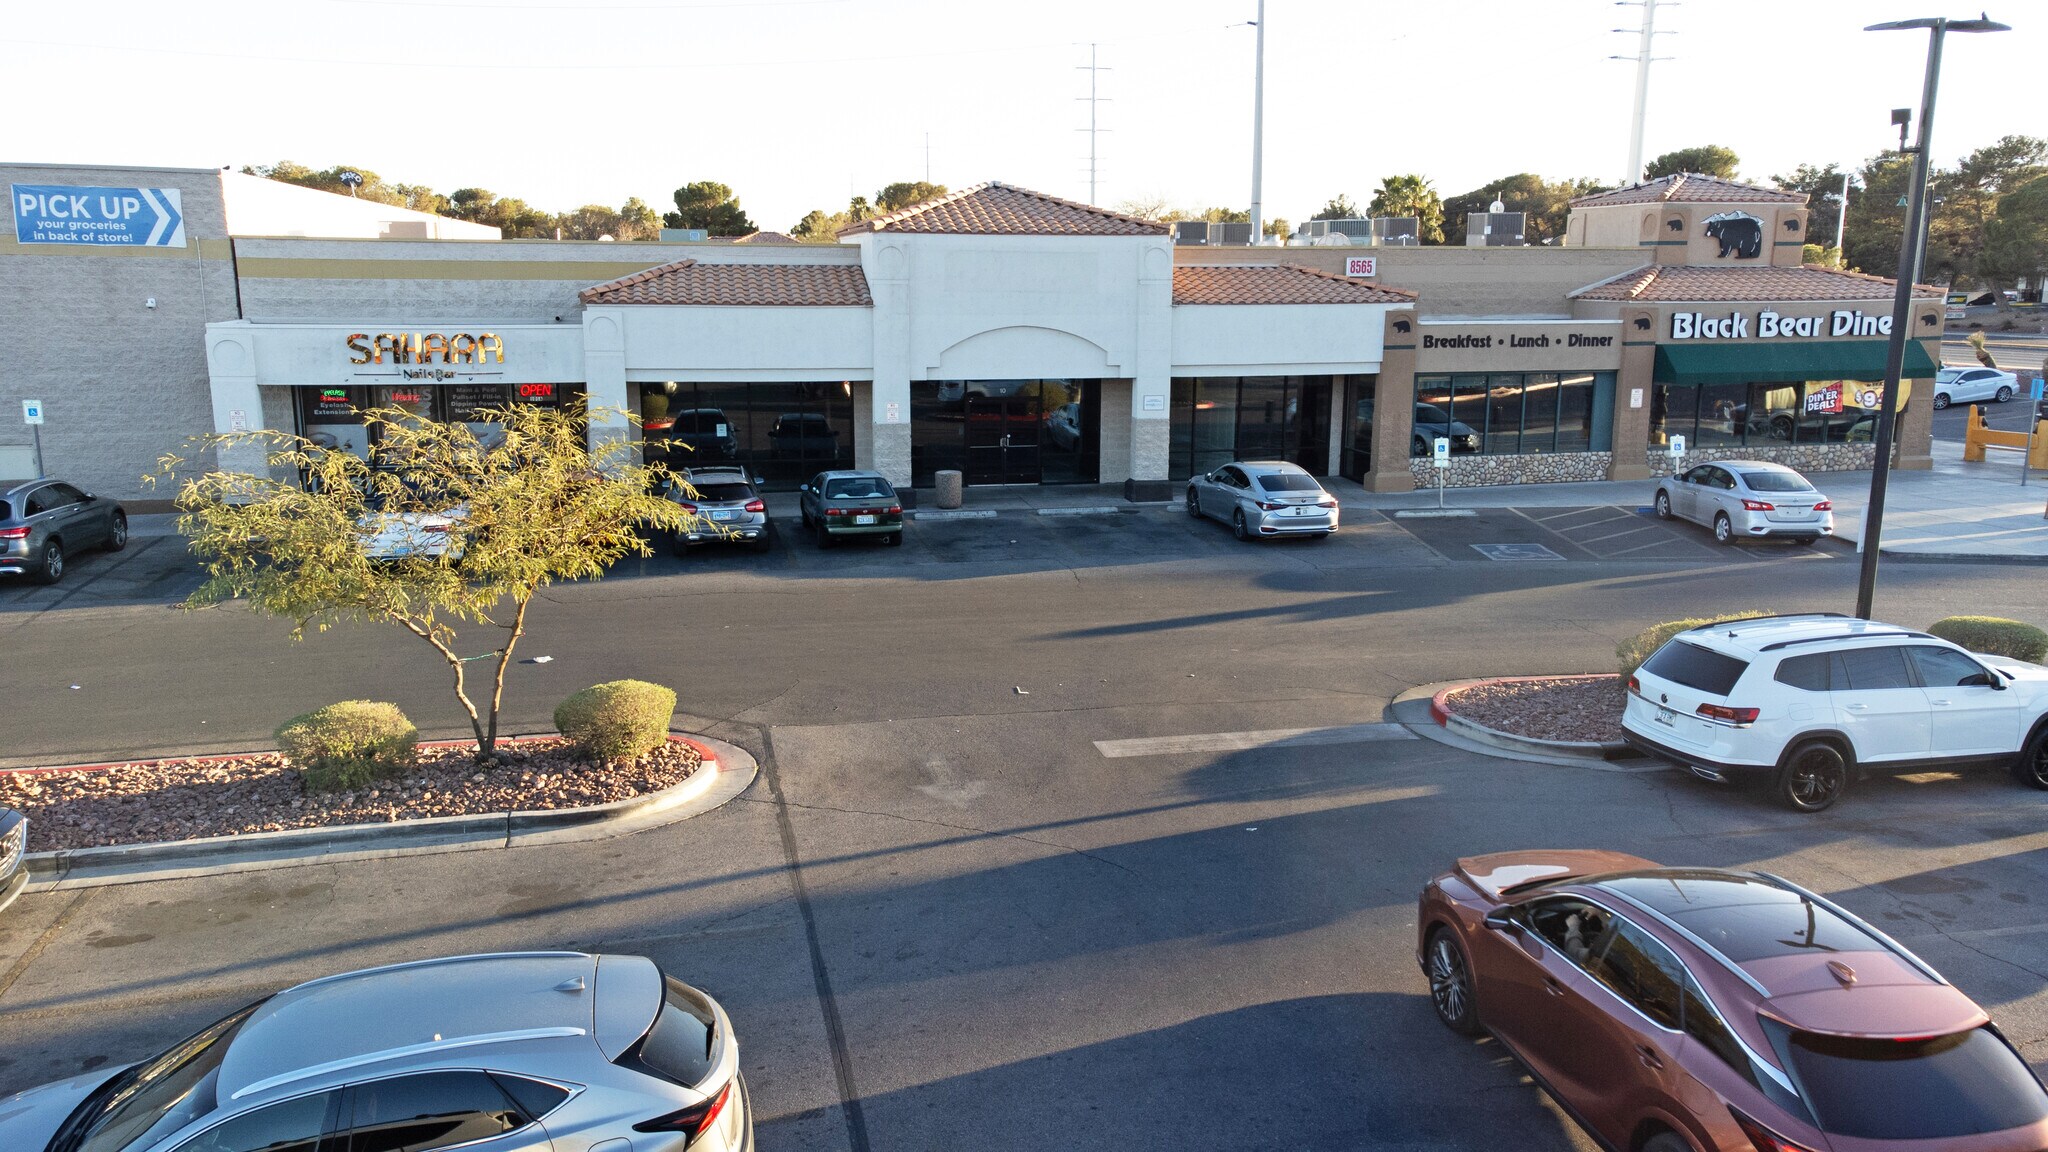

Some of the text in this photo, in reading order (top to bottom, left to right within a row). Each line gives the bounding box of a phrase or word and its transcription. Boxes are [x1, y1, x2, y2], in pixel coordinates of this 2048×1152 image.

[19, 194, 141, 220] PICK UP
[37, 220, 127, 231] your groceries
[33, 231, 134, 242] in back of store!
[1350, 260, 1373, 274] 8565
[1671, 310, 1894, 339] Black Bear Dine
[1423, 333, 1614, 349] Breakfast Lunch Dinner
[346, 332, 505, 365] SAHARA
[520, 383, 552, 397] OPEN
[1807, 399, 1836, 412] DEALS
